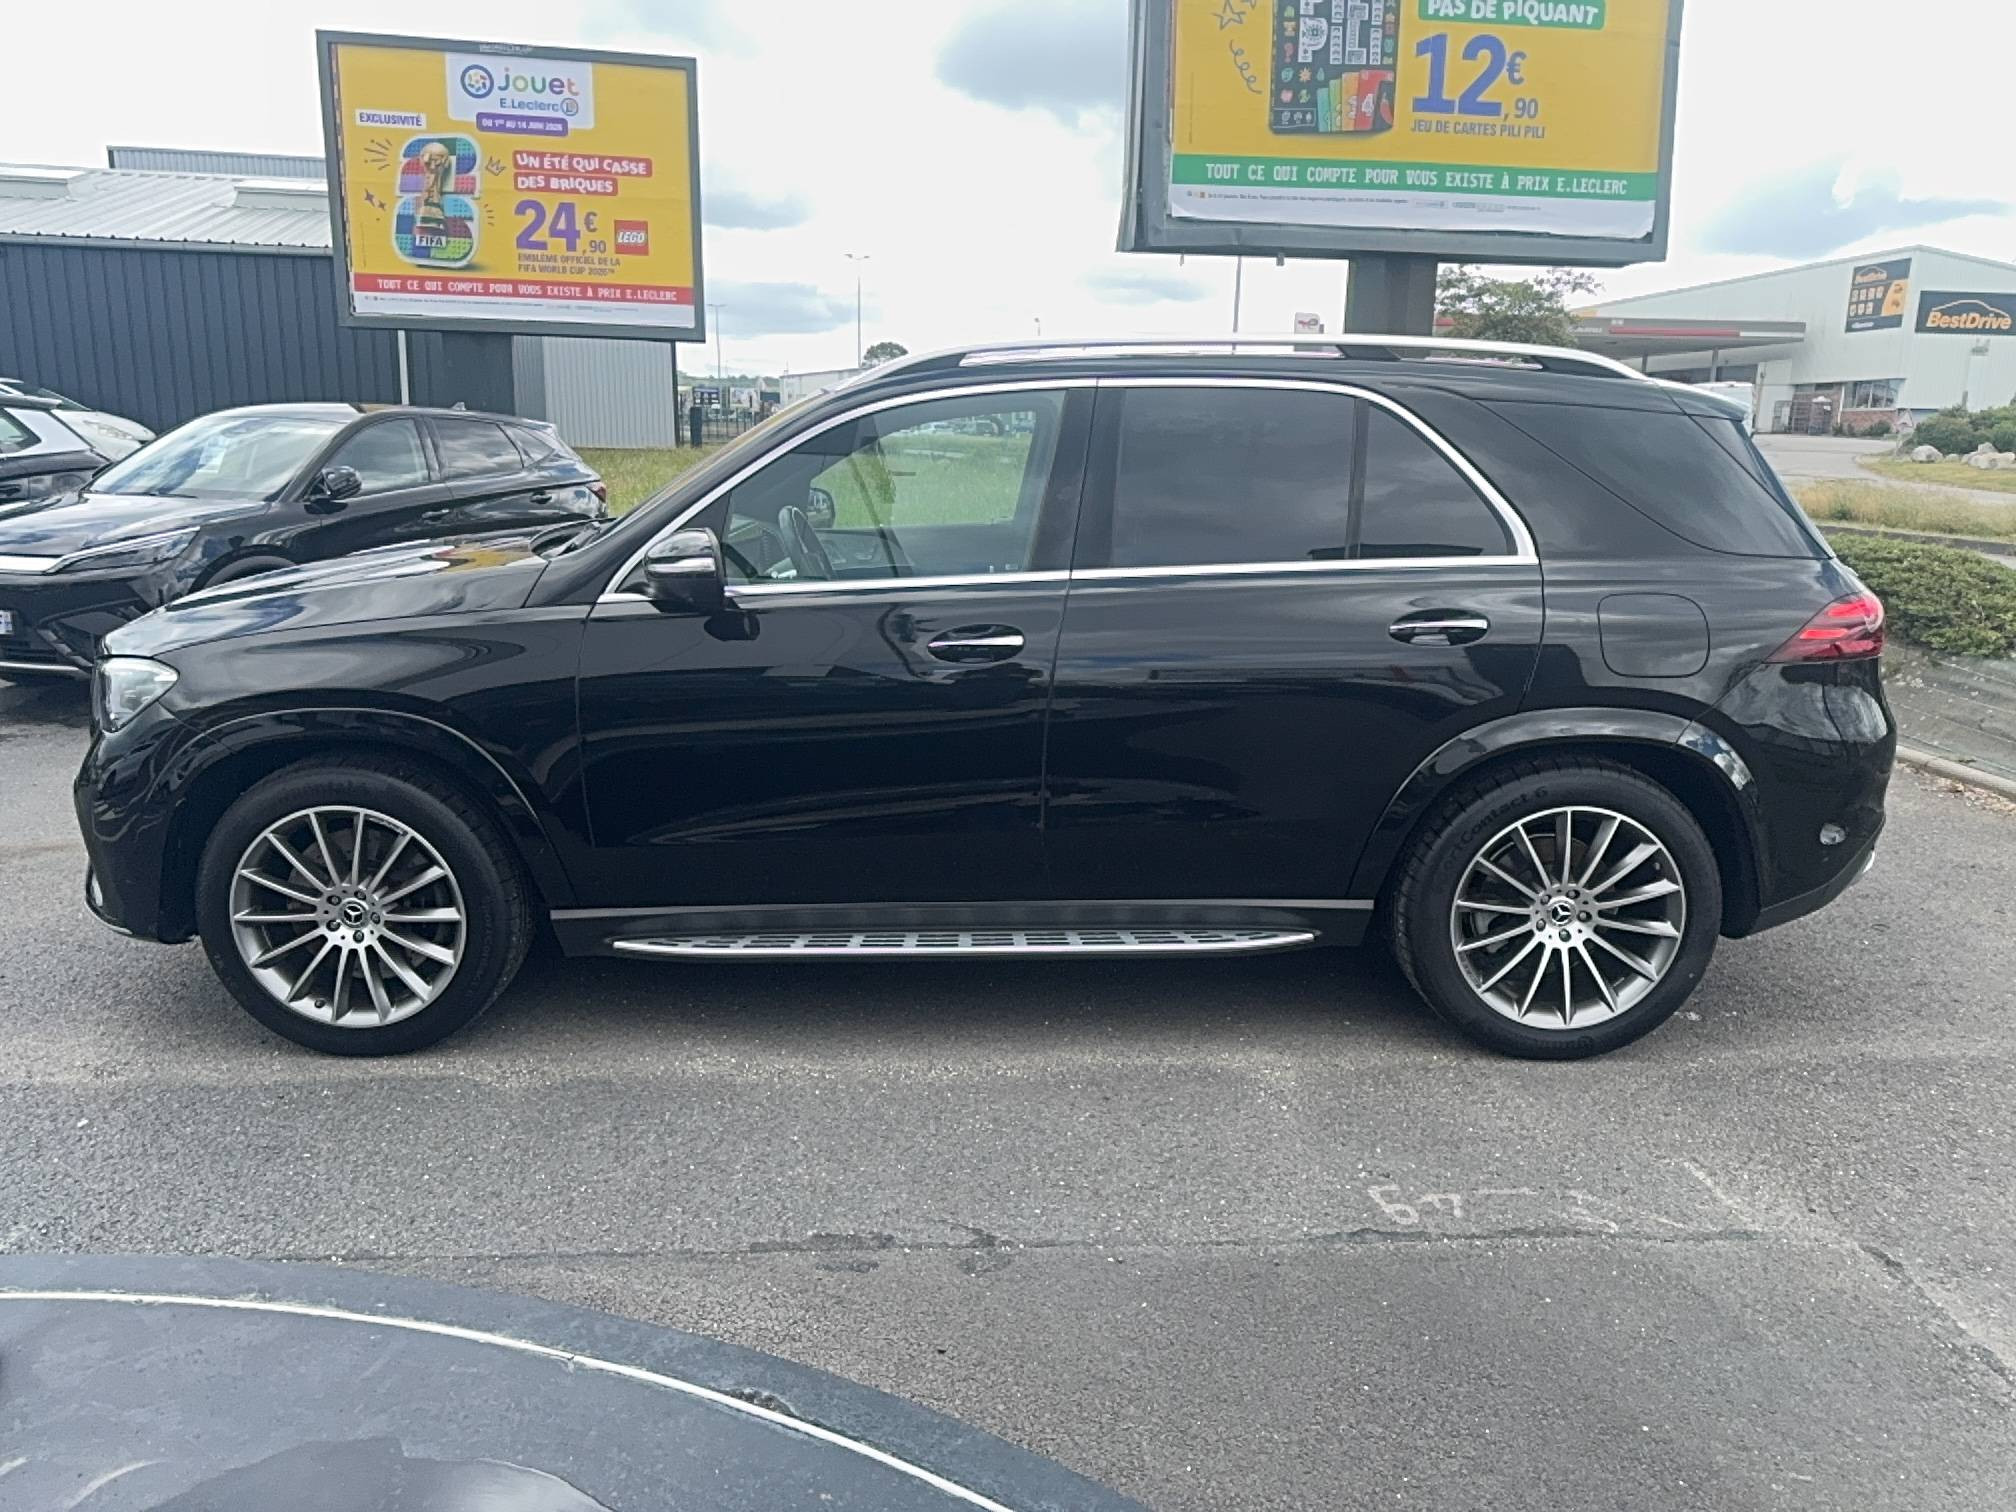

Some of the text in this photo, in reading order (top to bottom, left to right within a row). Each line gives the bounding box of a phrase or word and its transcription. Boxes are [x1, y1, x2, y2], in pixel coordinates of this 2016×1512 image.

[1427, 0, 1599, 24] PAS DE PIQUANT
[497, 67, 580, 96] jouet
[1412, 32, 1506, 116] 12
[499, 97, 560, 113] E.Leclerc
[359, 112, 422, 127] EXCLUSIVITÉ
[1410, 119, 1545, 139] JEU DE CARTES PILI PILI
[516, 152, 647, 175] UN ÉTÉ QUI CASSE
[517, 175, 614, 194] DES BRIQUES
[1205, 163, 1628, 195] TOUT CE QUI COMPTE POUR VOUS EXISTE À PRIX E.LECLERC
[514, 199, 581, 252] 24
[419, 238, 443, 247] FIFA
[617, 231, 646, 244] LEGO
[518, 263, 537, 273] FIFA
[538, 264, 568, 274] WORLD
[570, 265, 586, 275] CUP
[560, 255, 596, 265] OFFICIEL
[598, 256, 609, 265] DE
[611, 257, 621, 266] LA
[377, 279, 678, 301] TOUT CE QUI COMPTE POUR VOUS EXISTE À PRIX E.LECLERC
[1926, 311, 2013, 330] BestDrive
